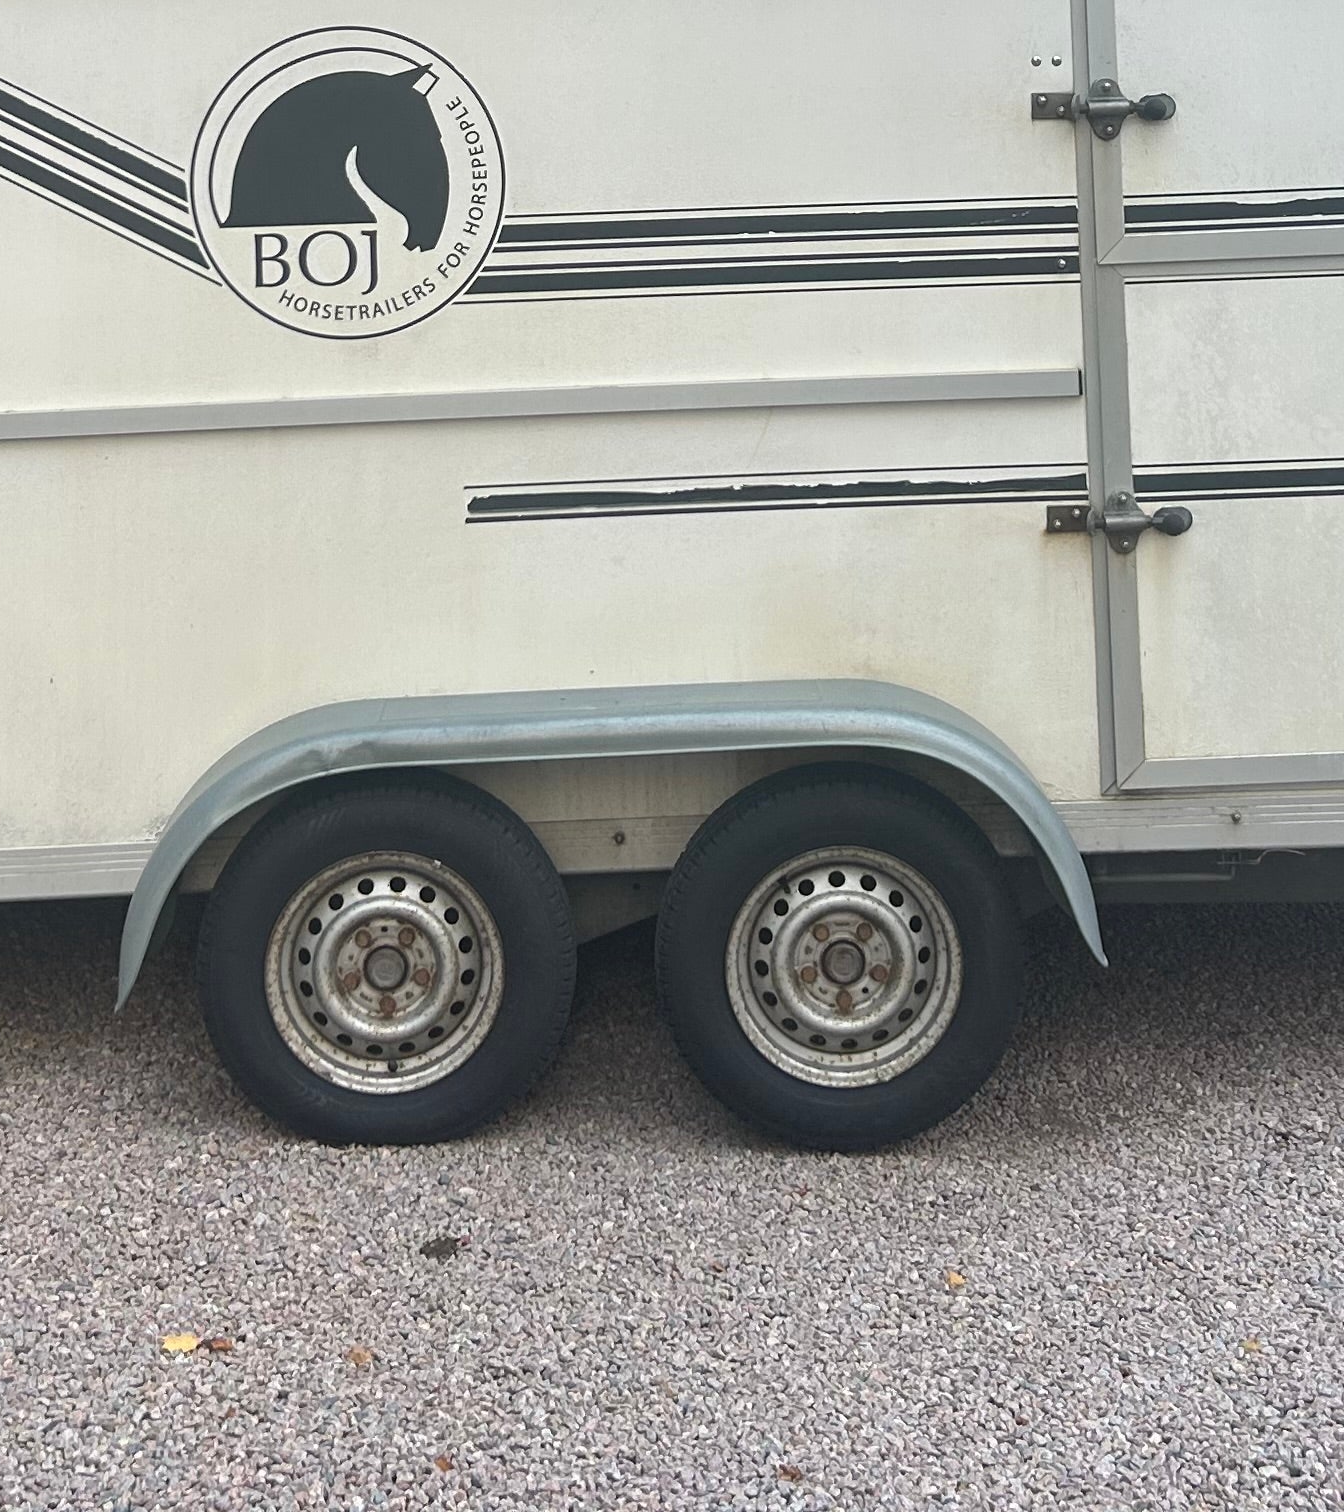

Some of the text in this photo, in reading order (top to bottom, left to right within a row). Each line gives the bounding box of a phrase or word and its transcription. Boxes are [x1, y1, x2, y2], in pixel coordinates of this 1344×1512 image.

[254, 229, 379, 295] BOJ
[278, 95, 488, 320] HORSETRAILERS FOR HORSEPEOPLE
